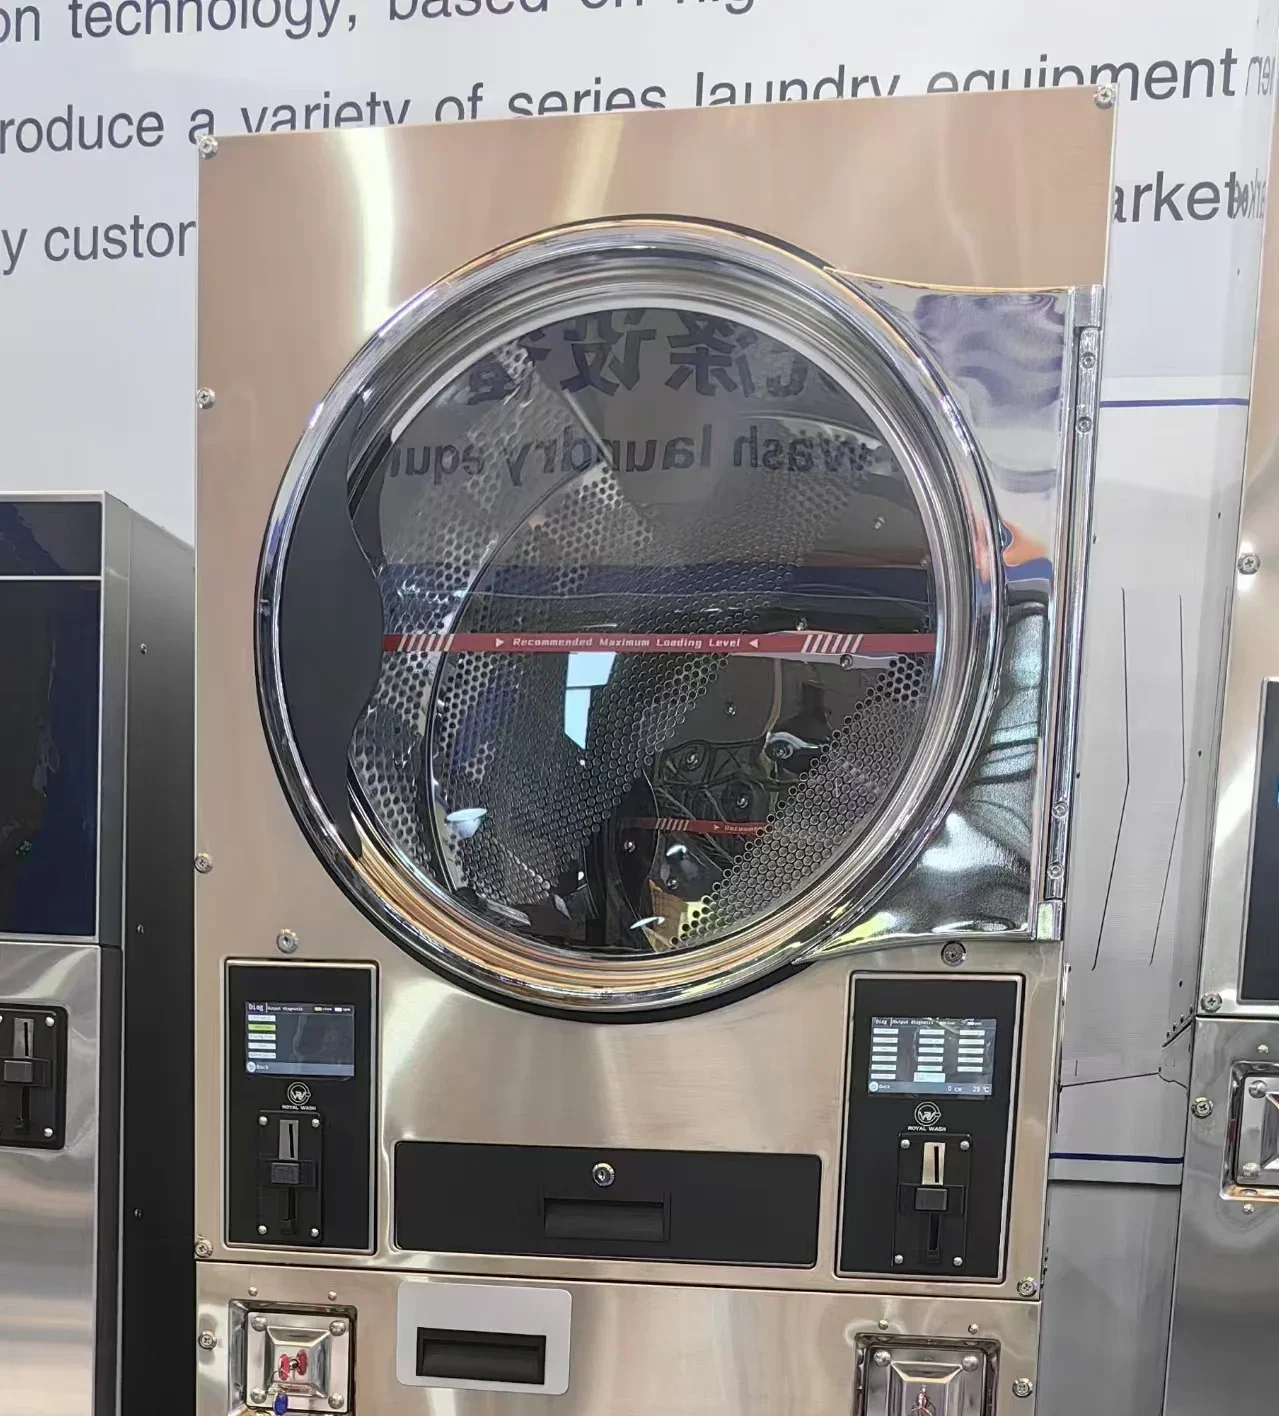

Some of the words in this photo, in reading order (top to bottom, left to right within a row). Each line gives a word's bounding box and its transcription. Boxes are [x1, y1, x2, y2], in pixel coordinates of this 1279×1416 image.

[69, 0, 357, 40] technology,
[0, 104, 164, 153] roduce
[189, 109, 215, 145] a
[435, 82, 484, 121] of
[508, 77, 667, 117] series
[512, 636, 593, 647] Recommended
[600, 638, 650, 647] Maximum
[656, 638, 702, 649] Loading
[709, 638, 740, 647] Level
[248, 1003, 264, 1012] Diag
